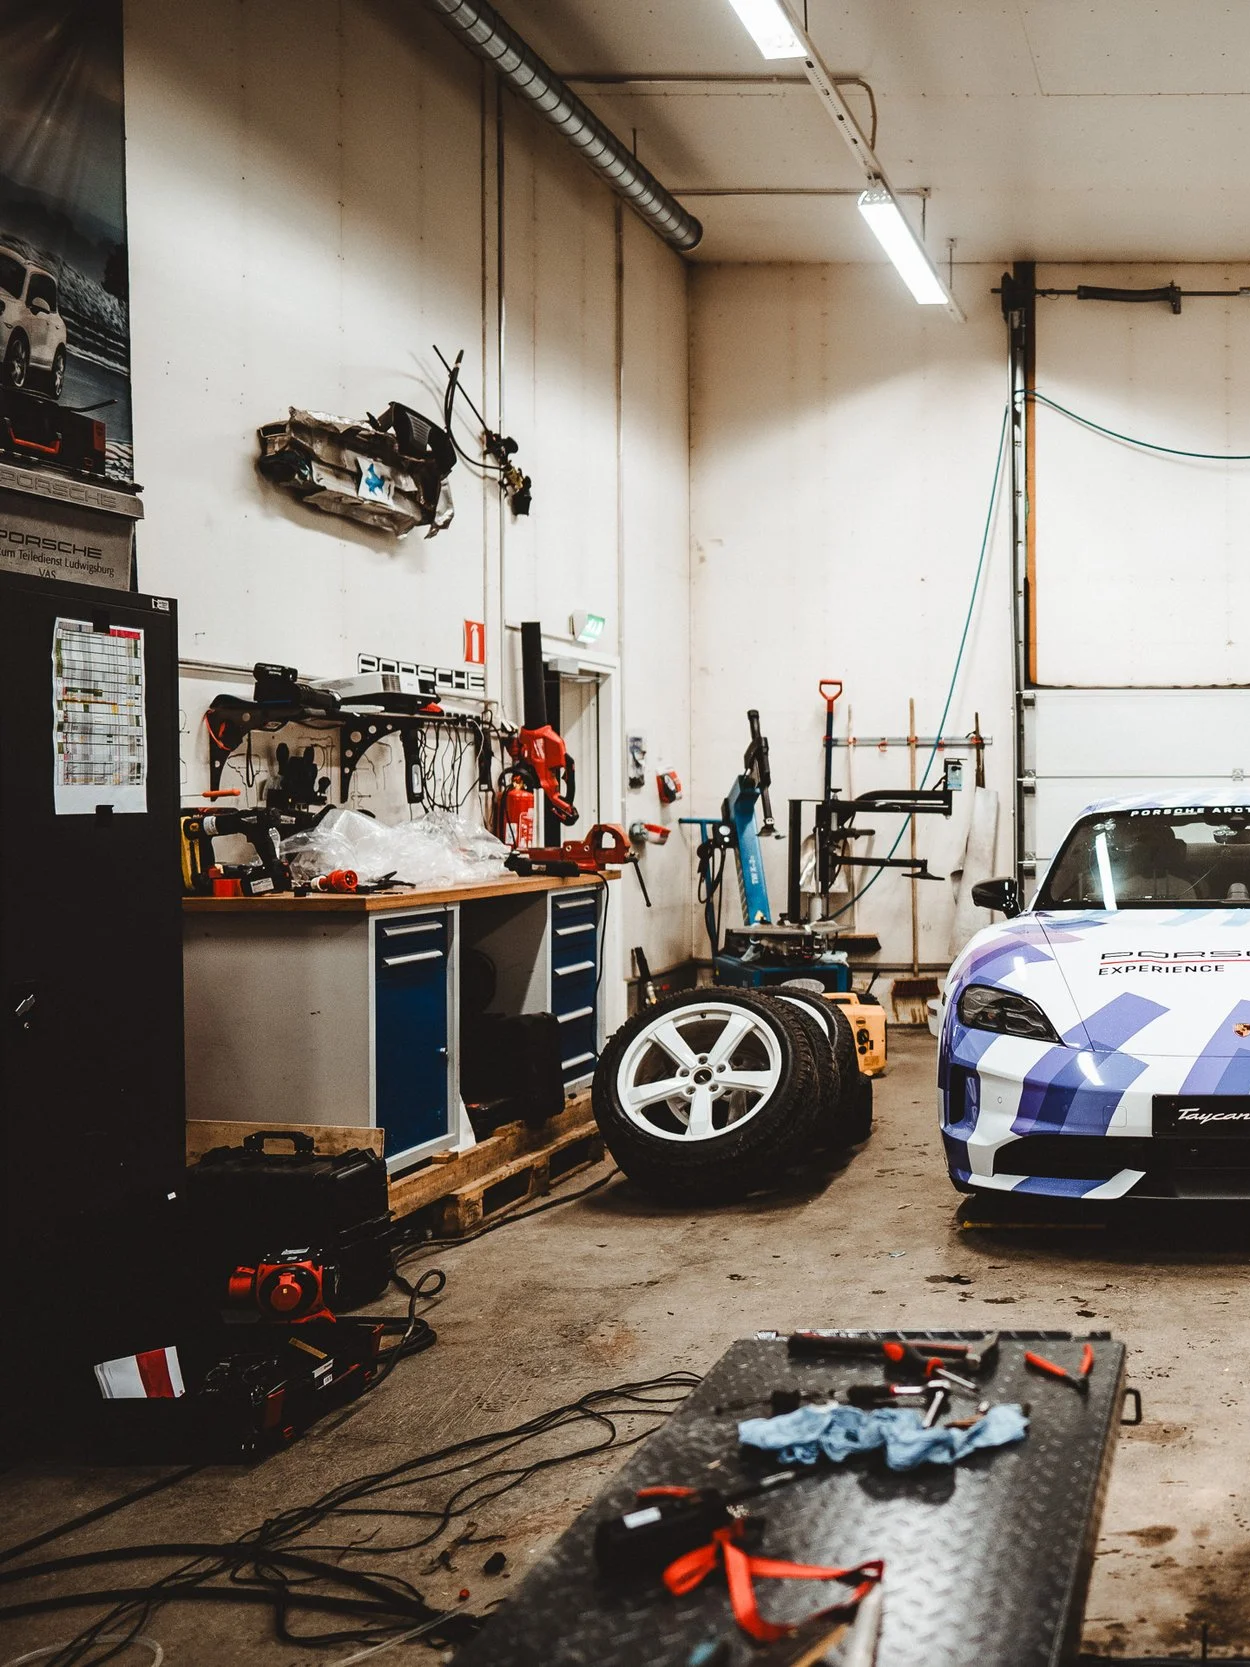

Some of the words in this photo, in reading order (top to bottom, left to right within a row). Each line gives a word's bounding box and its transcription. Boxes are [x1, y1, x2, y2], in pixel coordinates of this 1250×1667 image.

[0, 470, 117, 508] PORSCHE
[19, 549, 63, 567] Teiledienst
[64, 557, 115, 578] Ludwigsburg
[38, 568, 57, 579] VAS
[358, 653, 485, 691] PORSCHE
[1130, 807, 1204, 817] PORSCHE
[1098, 964, 1225, 976] EXPERIENCE
